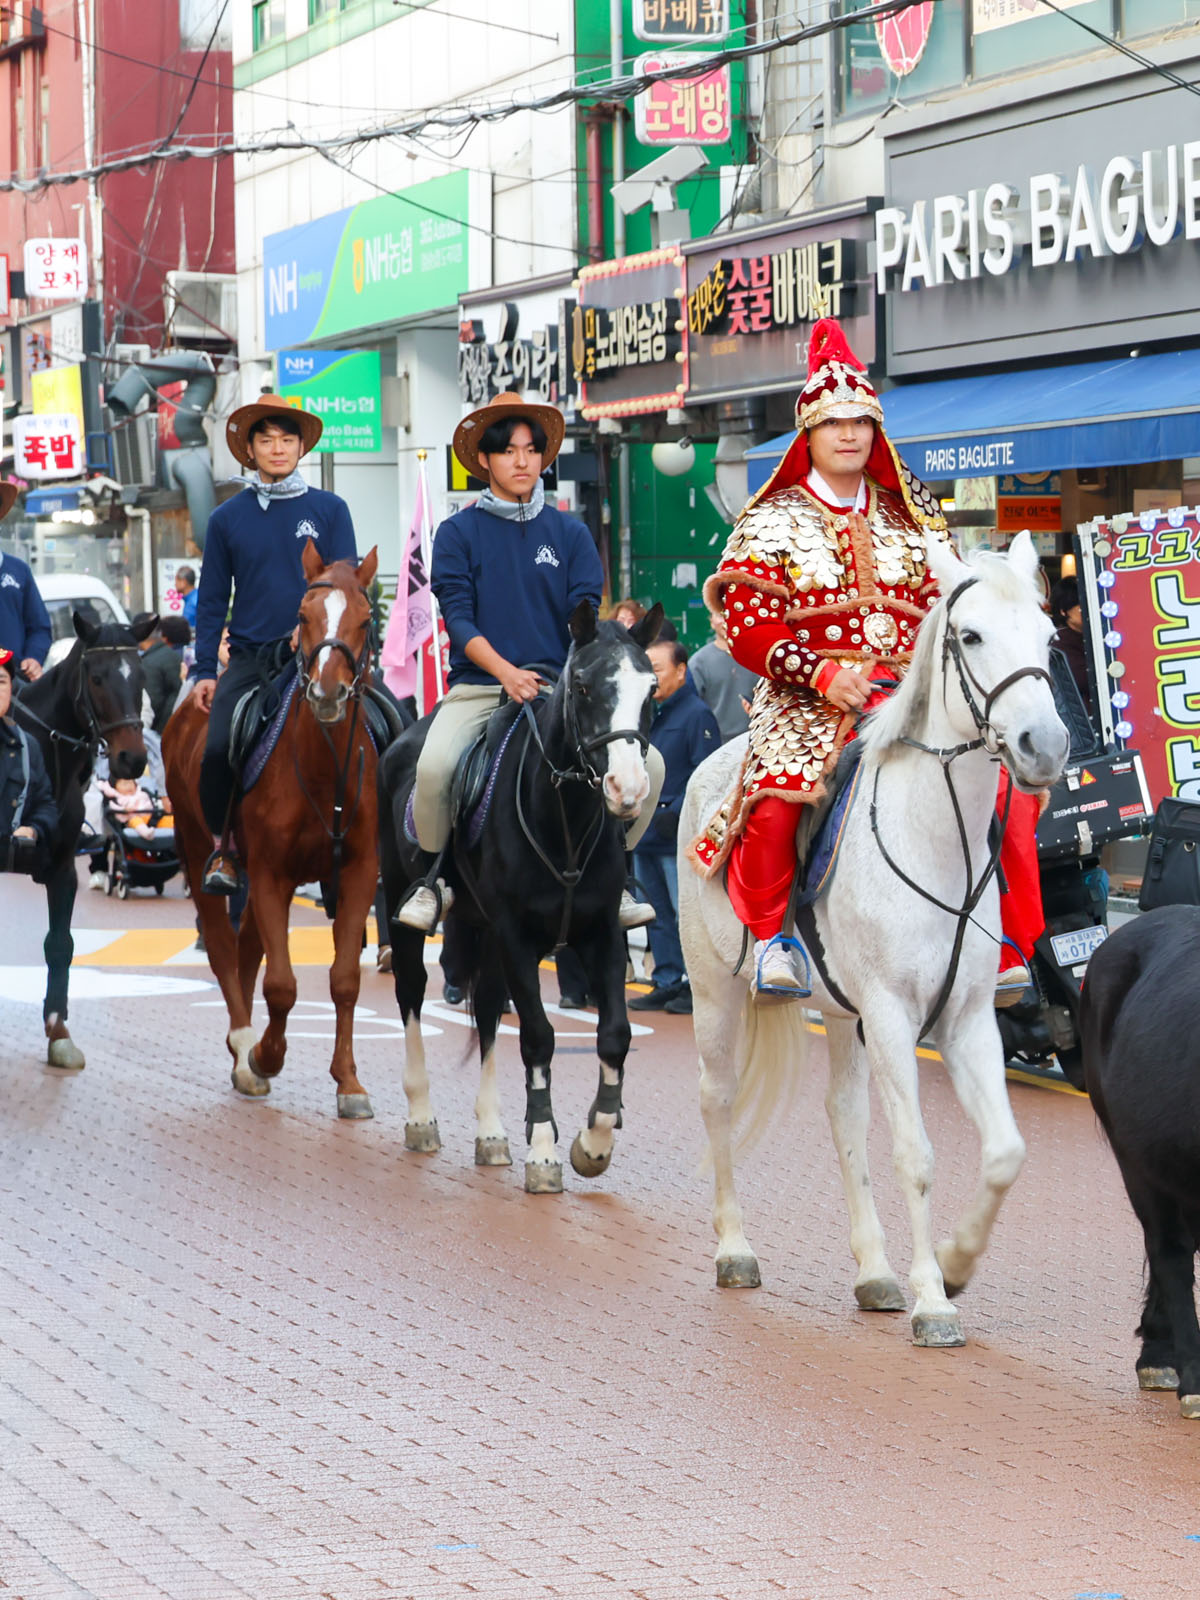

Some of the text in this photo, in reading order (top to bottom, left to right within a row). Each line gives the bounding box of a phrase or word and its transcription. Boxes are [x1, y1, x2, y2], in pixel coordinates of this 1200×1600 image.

[647, 82, 725, 134] 노래방
[365, 226, 413, 285] NH농협
[875, 182, 1020, 295] PARIS
[269, 261, 297, 317] NH
[596, 298, 667, 370] 노래연습장
[285, 358, 314, 369] NH
[305, 396, 375, 413] NH농협
[24, 434, 76, 470] 족발
[925, 442, 1014, 472] PARIS BAGUETTE
